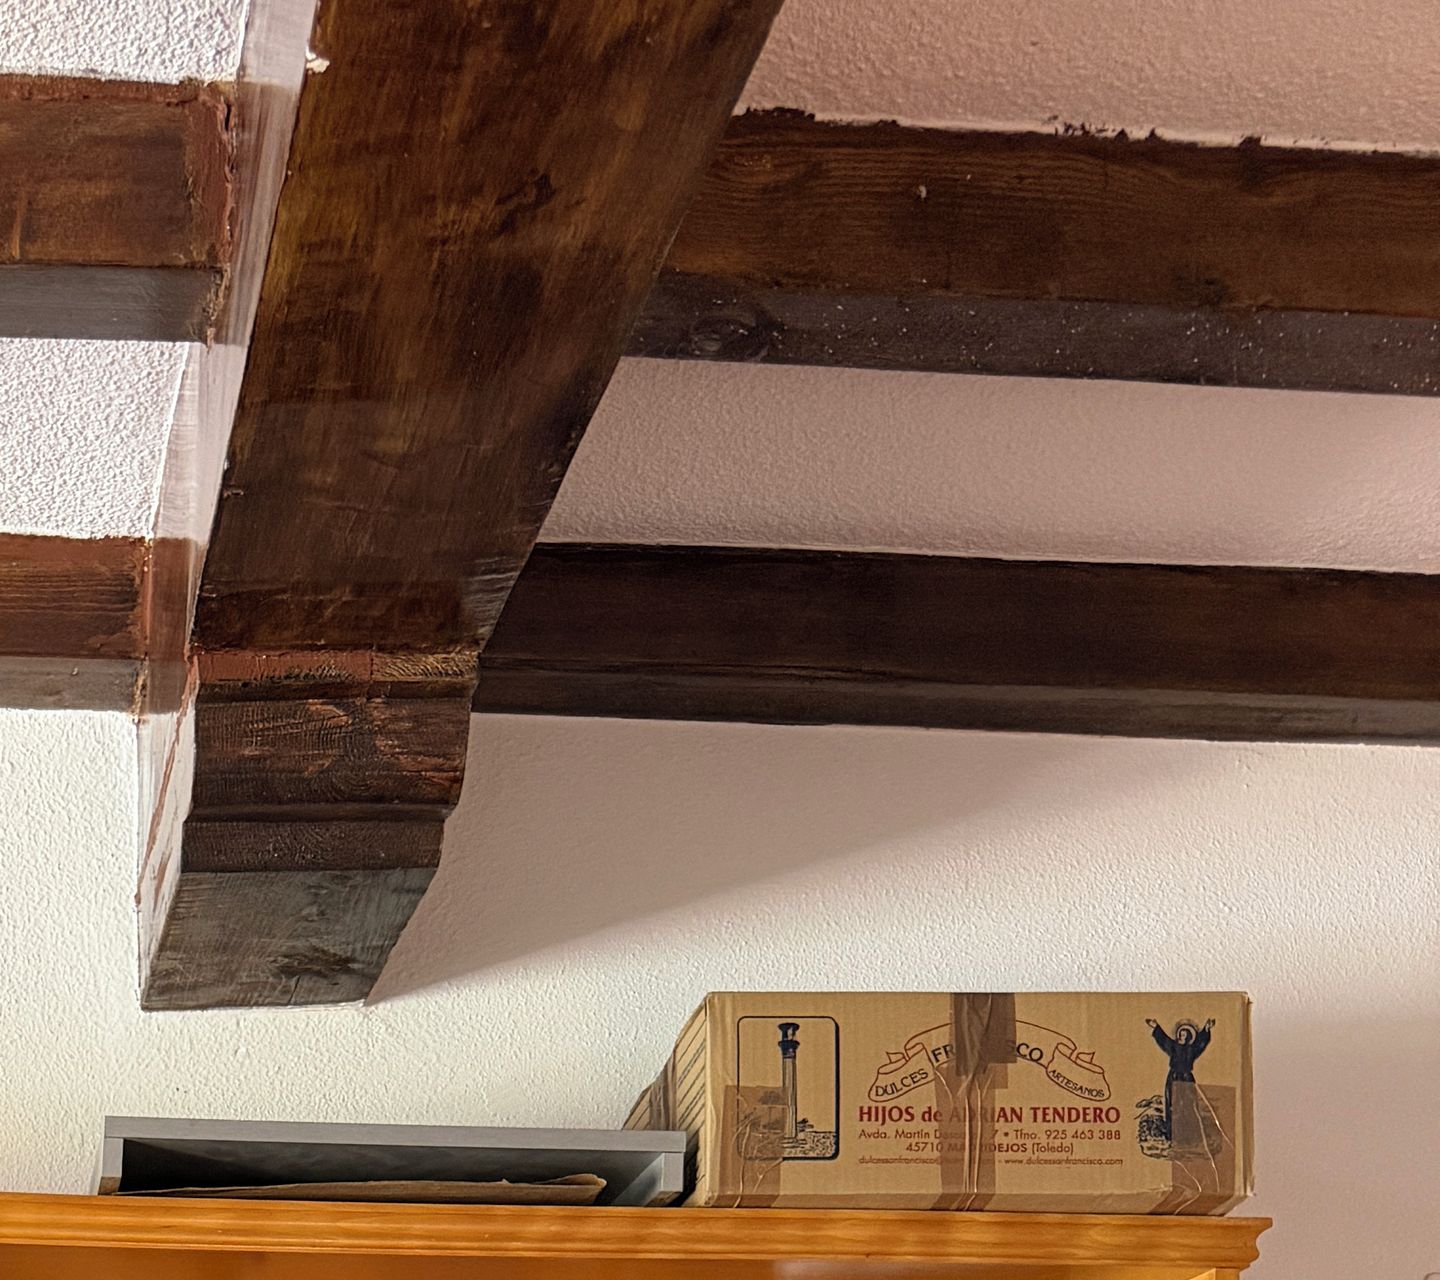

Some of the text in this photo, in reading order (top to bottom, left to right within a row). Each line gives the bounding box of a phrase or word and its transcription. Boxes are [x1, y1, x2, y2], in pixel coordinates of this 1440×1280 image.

[874, 1067, 929, 1098] DULCES
[1048, 1068, 1105, 1099] ARTESANOS
[858, 1105, 915, 1126] HIJOS
[920, 1105, 944, 1123] de
[1029, 1106, 1121, 1124] TENDERO
[858, 1129, 890, 1140] Avda.
[1045, 1129, 1068, 1140] 925
[1071, 1129, 1094, 1140] 463
[1098, 1129, 1121, 1141] 388
[905, 1141, 944, 1153] 45710
[1031, 1142, 1074, 1156] (Toledo)
